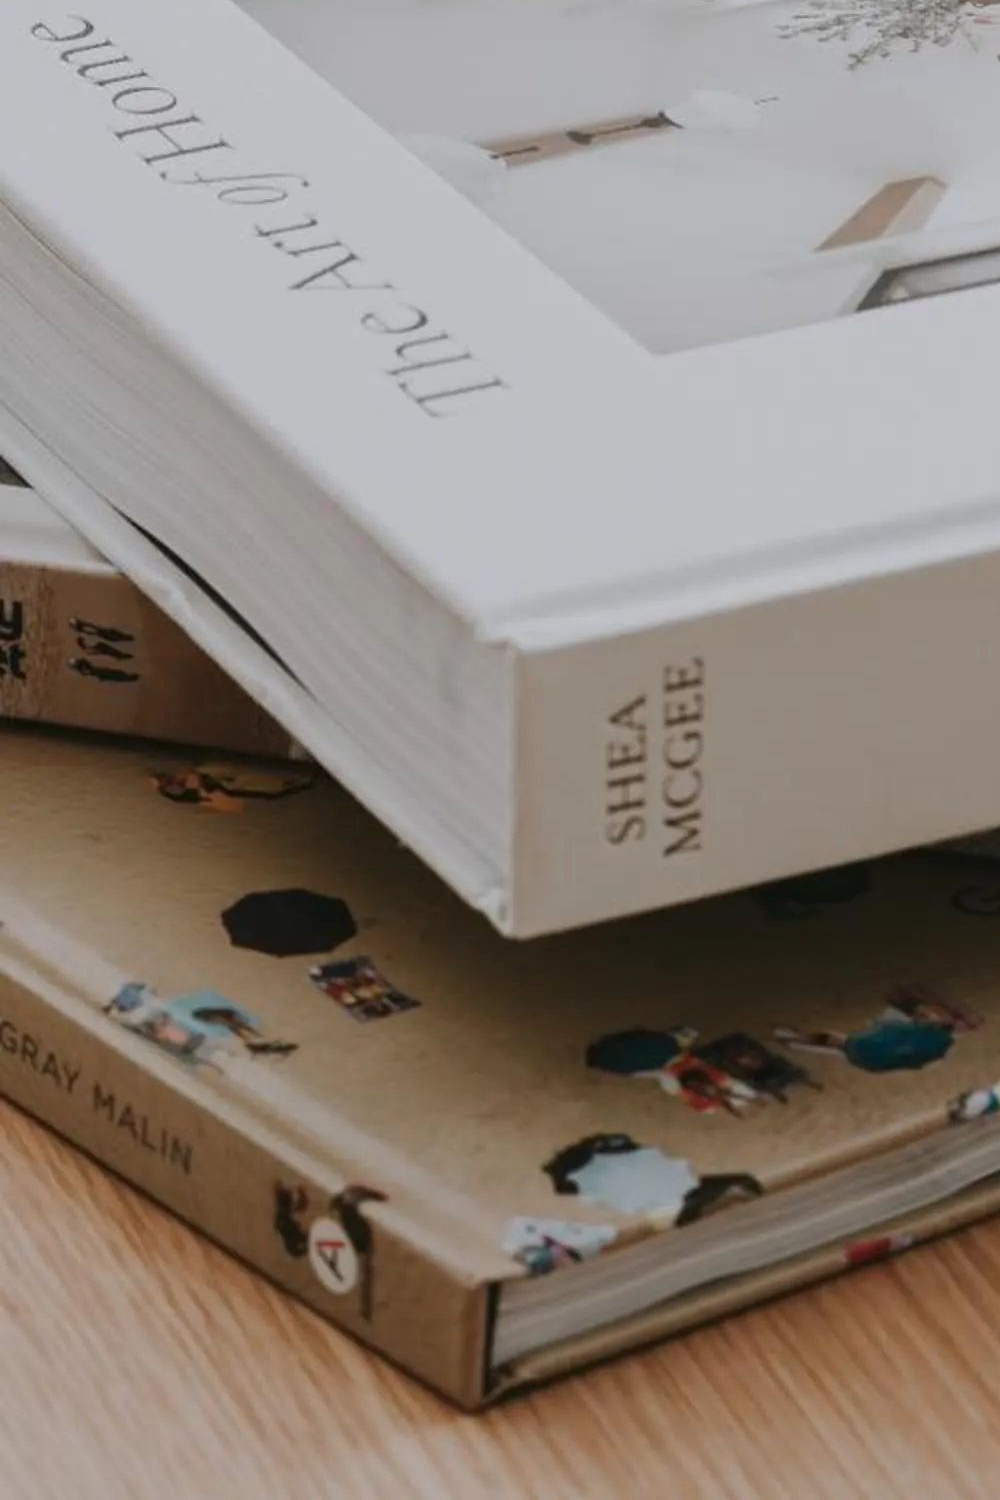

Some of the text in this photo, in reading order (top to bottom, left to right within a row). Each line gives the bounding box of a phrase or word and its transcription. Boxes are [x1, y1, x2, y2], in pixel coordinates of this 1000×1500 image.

[29, 12, 508, 418] The Art of Home
[606, 694, 648, 846] SHEA
[662, 656, 704, 858] MCGEE
[0, 1020, 193, 1176] GRAY MALIN
